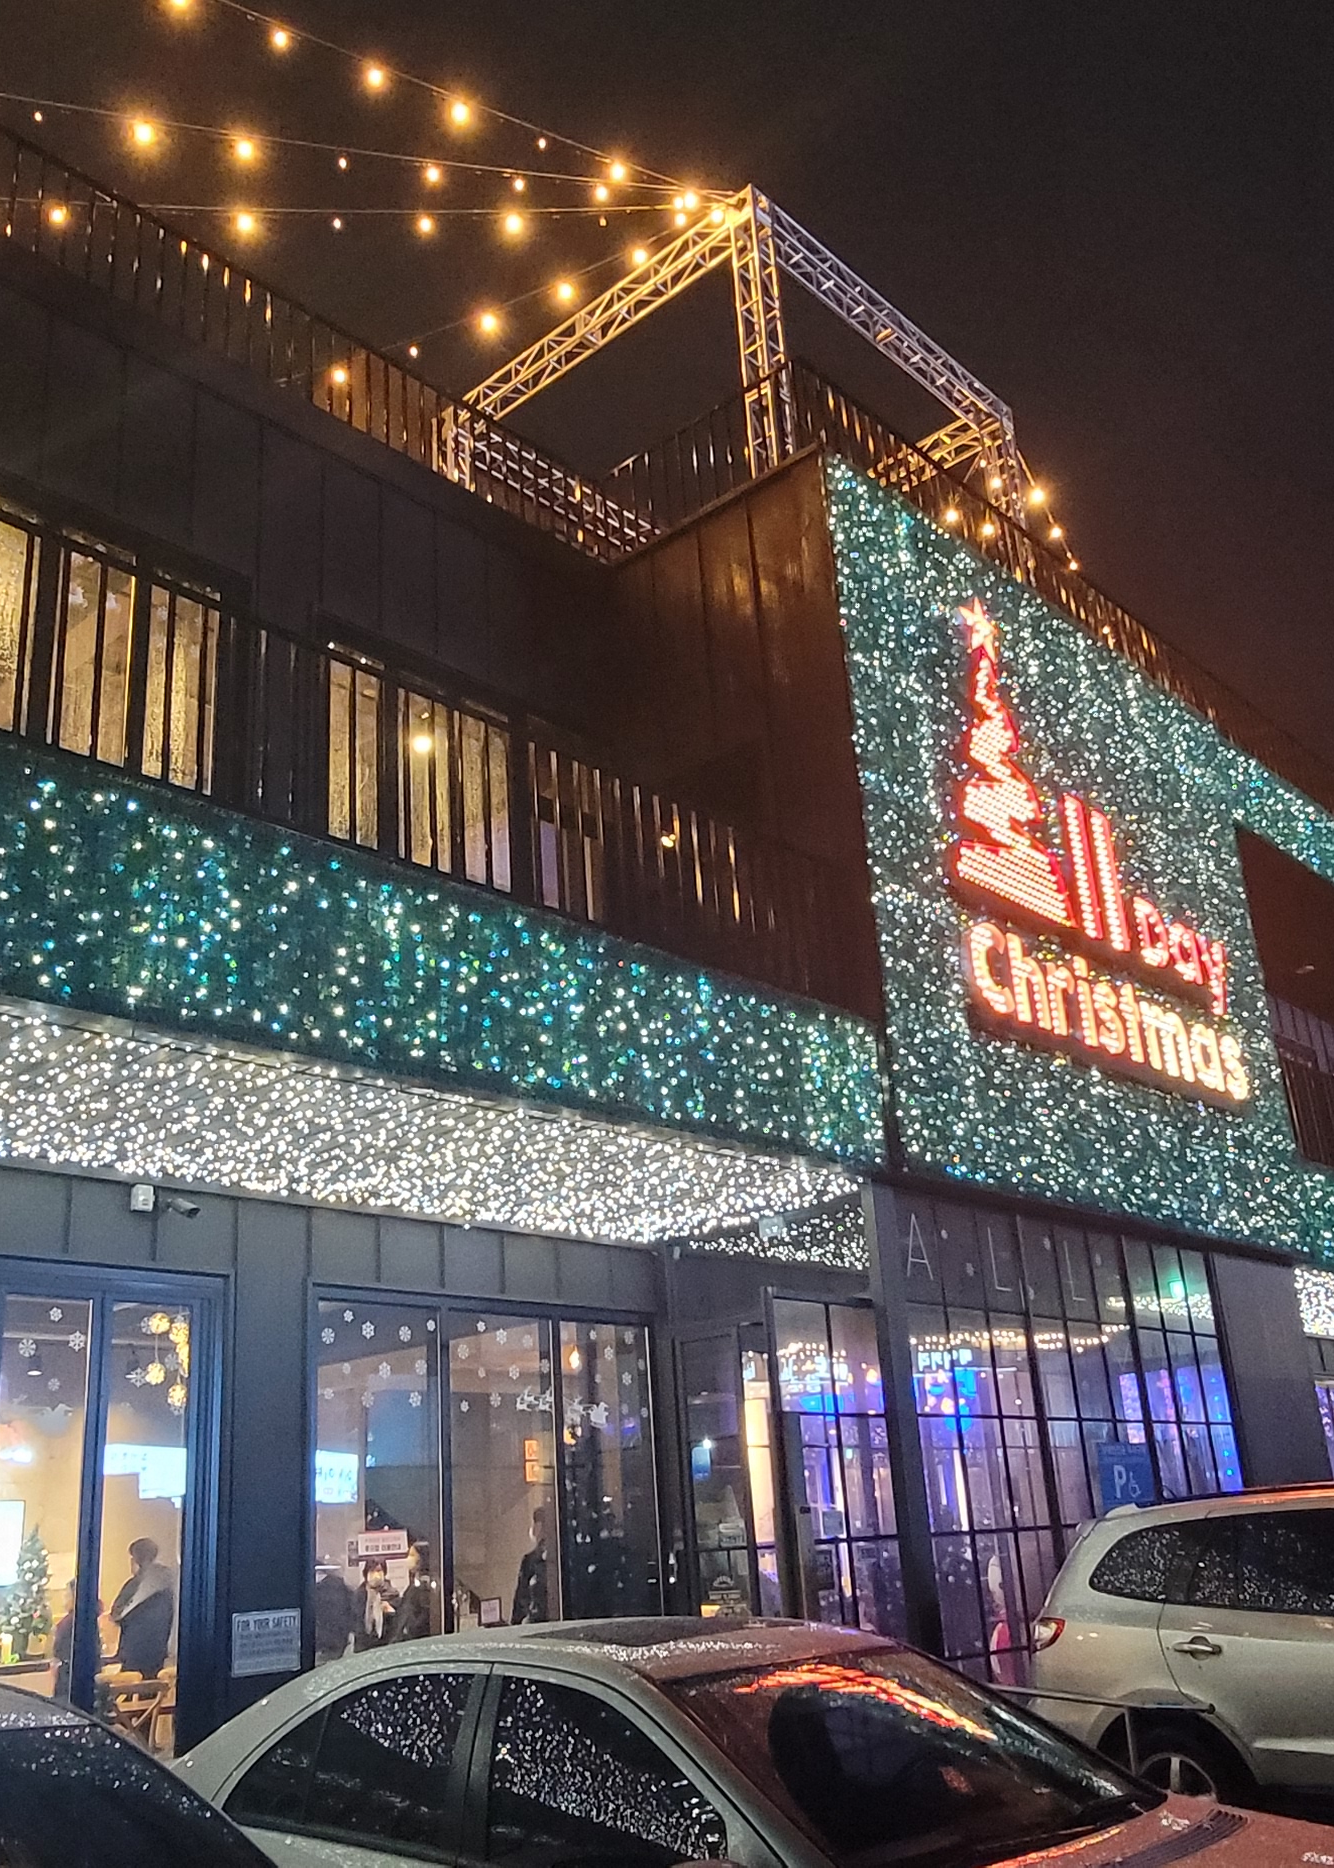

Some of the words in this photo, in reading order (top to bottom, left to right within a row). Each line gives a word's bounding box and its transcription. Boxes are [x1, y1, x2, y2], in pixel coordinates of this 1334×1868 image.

[968, 921, 1250, 1100] Christmas
[1113, 1464, 1127, 1499] P
[236, 1619, 251, 1632] FOR
[272, 1614, 297, 1629] SAFETY
